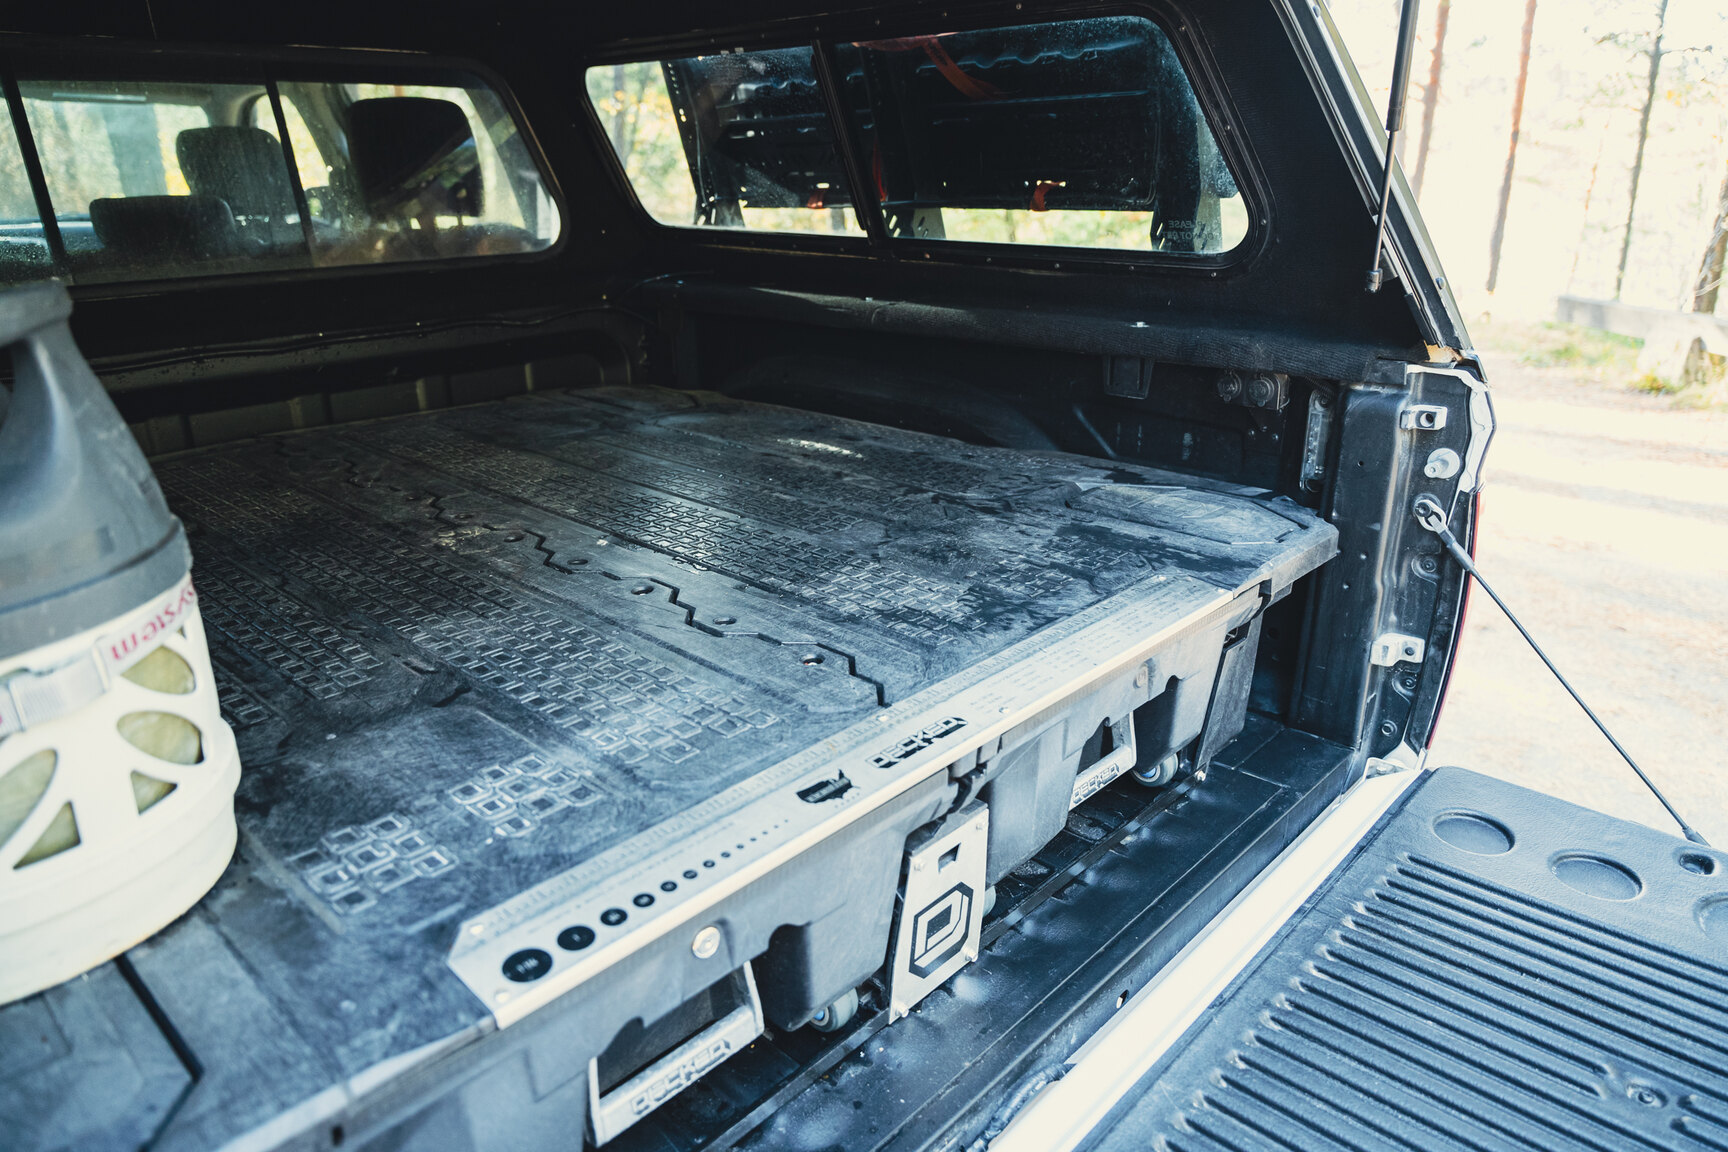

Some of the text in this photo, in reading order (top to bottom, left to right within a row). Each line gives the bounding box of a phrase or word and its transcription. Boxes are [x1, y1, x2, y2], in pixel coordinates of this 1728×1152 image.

[866, 715, 968, 769] DECKED
[1072, 762, 1120, 804] DECKED
[632, 1039, 731, 1115] DECKED
